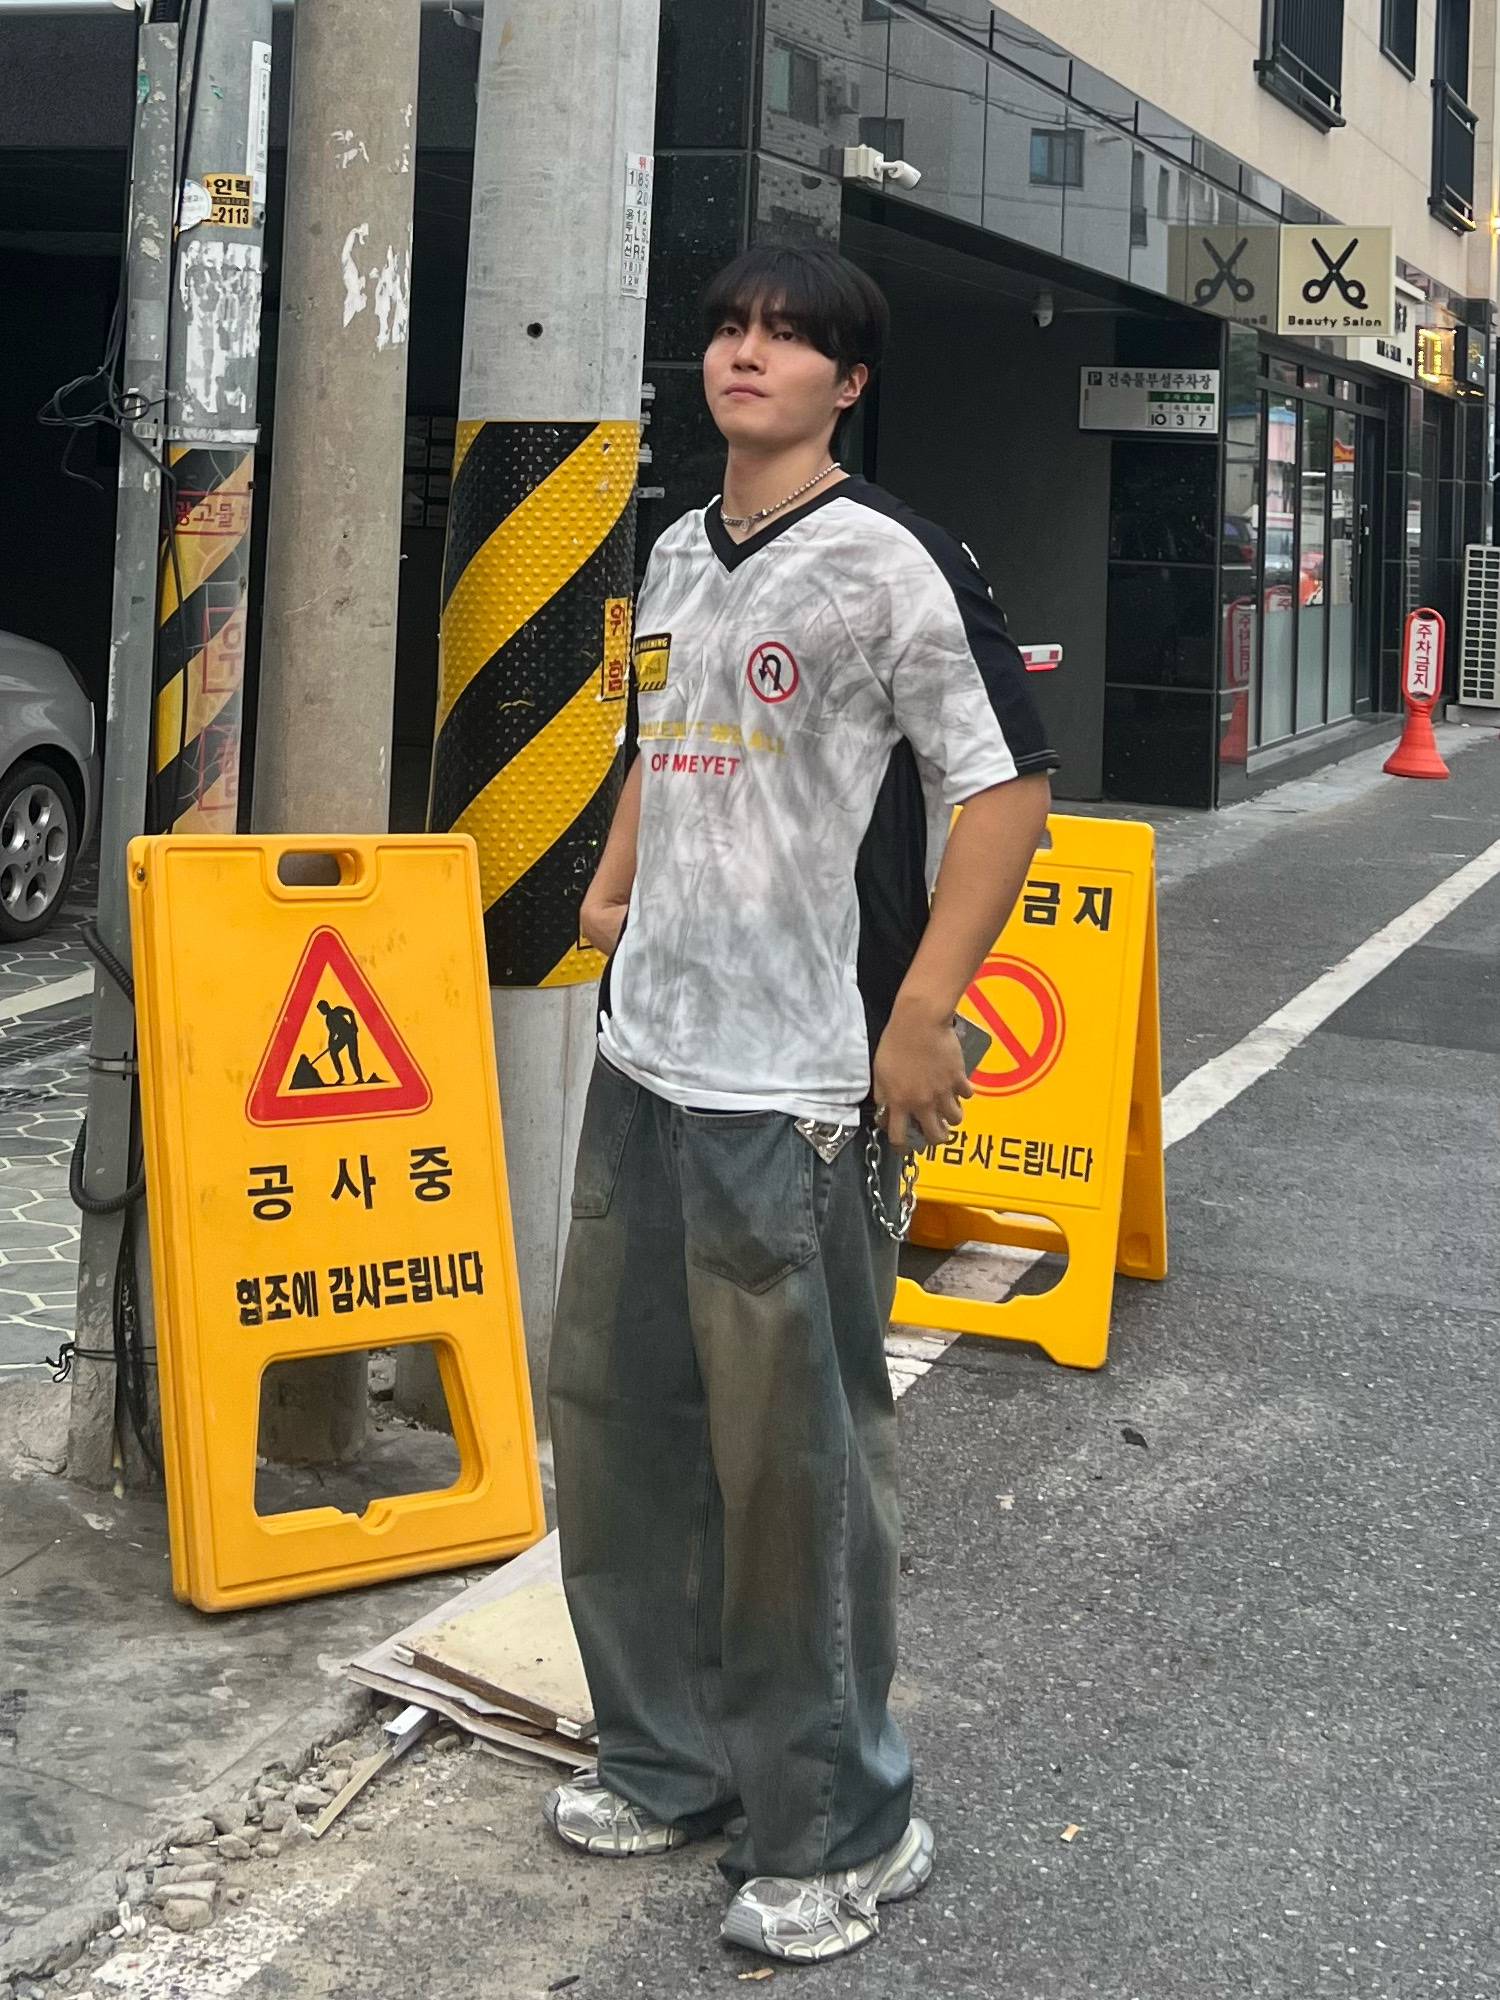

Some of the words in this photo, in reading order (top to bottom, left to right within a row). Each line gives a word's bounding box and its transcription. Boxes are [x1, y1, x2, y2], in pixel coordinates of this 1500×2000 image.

[200, 206, 249, 224] -2113
[1288, 315, 1338, 328] Beauty
[1342, 316, 1382, 327] Salon
[1150, 413, 1168, 426] 10
[1175, 414, 1185, 426] 3
[1198, 415, 1207, 427] 7
[1413, 623, 1433, 689] 주차금지
[651, 753, 669, 772] OF
[672, 753, 741, 776] MEYET
[1022, 879, 1113, 931] 금지
[236, 1270, 319, 1327] 협조에
[328, 1250, 484, 1315] 감사드립니다
